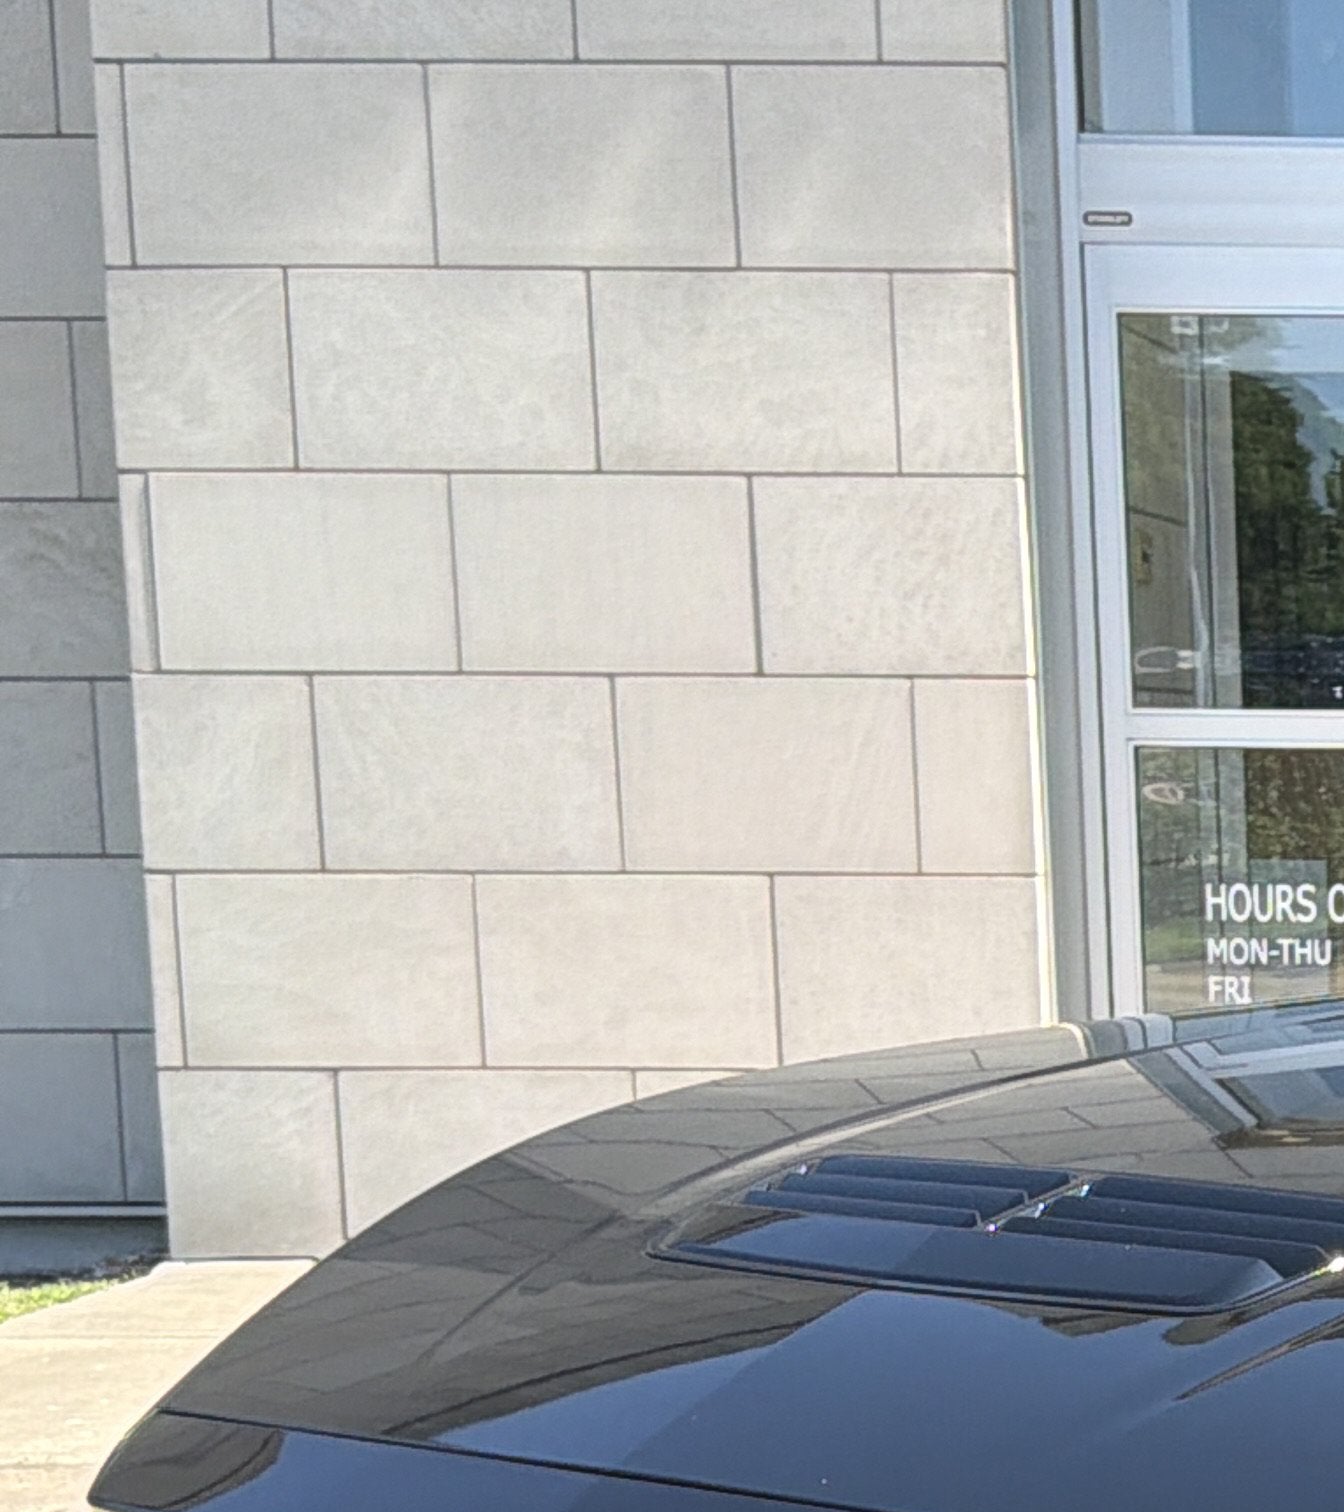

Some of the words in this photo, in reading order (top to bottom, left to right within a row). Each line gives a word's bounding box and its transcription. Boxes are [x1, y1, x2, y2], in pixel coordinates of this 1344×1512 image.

[1204, 883, 1317, 923] HOURS
[1206, 937, 1332, 966] MON-THU
[1208, 975, 1253, 1003] FRI
